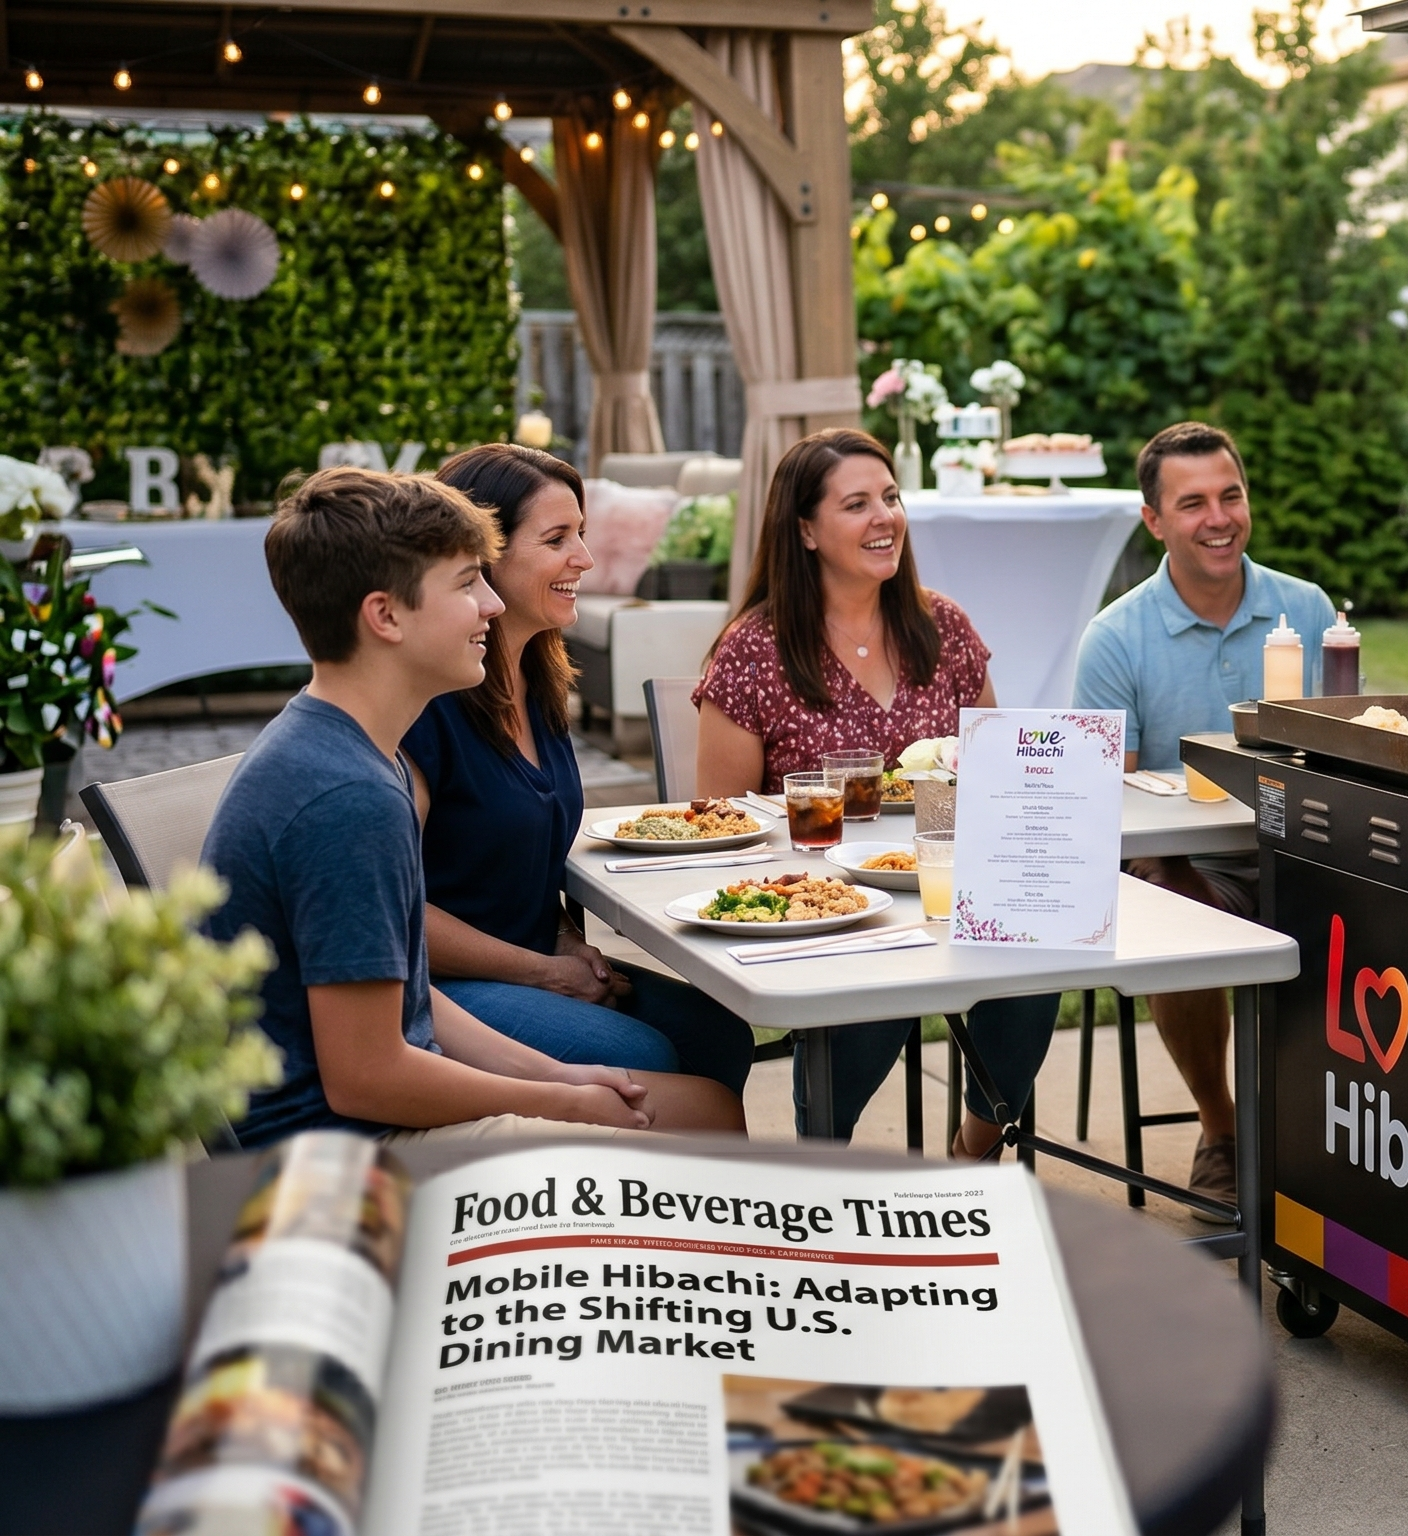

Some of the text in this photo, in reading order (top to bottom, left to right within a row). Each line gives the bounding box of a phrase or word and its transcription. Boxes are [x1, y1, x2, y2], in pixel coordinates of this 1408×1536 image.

[1016, 745, 1065, 758] Hibachi
[451, 1177, 558, 1235] Food
[571, 1177, 606, 1216] &
[618, 1179, 834, 1243] Beverage
[842, 1198, 991, 1238] Times
[445, 1264, 999, 1312] Mobile Hibachi: Adapting
[441, 1295, 853, 1336] to the Shifting U.S.
[439, 1329, 756, 1370] Dining Market
